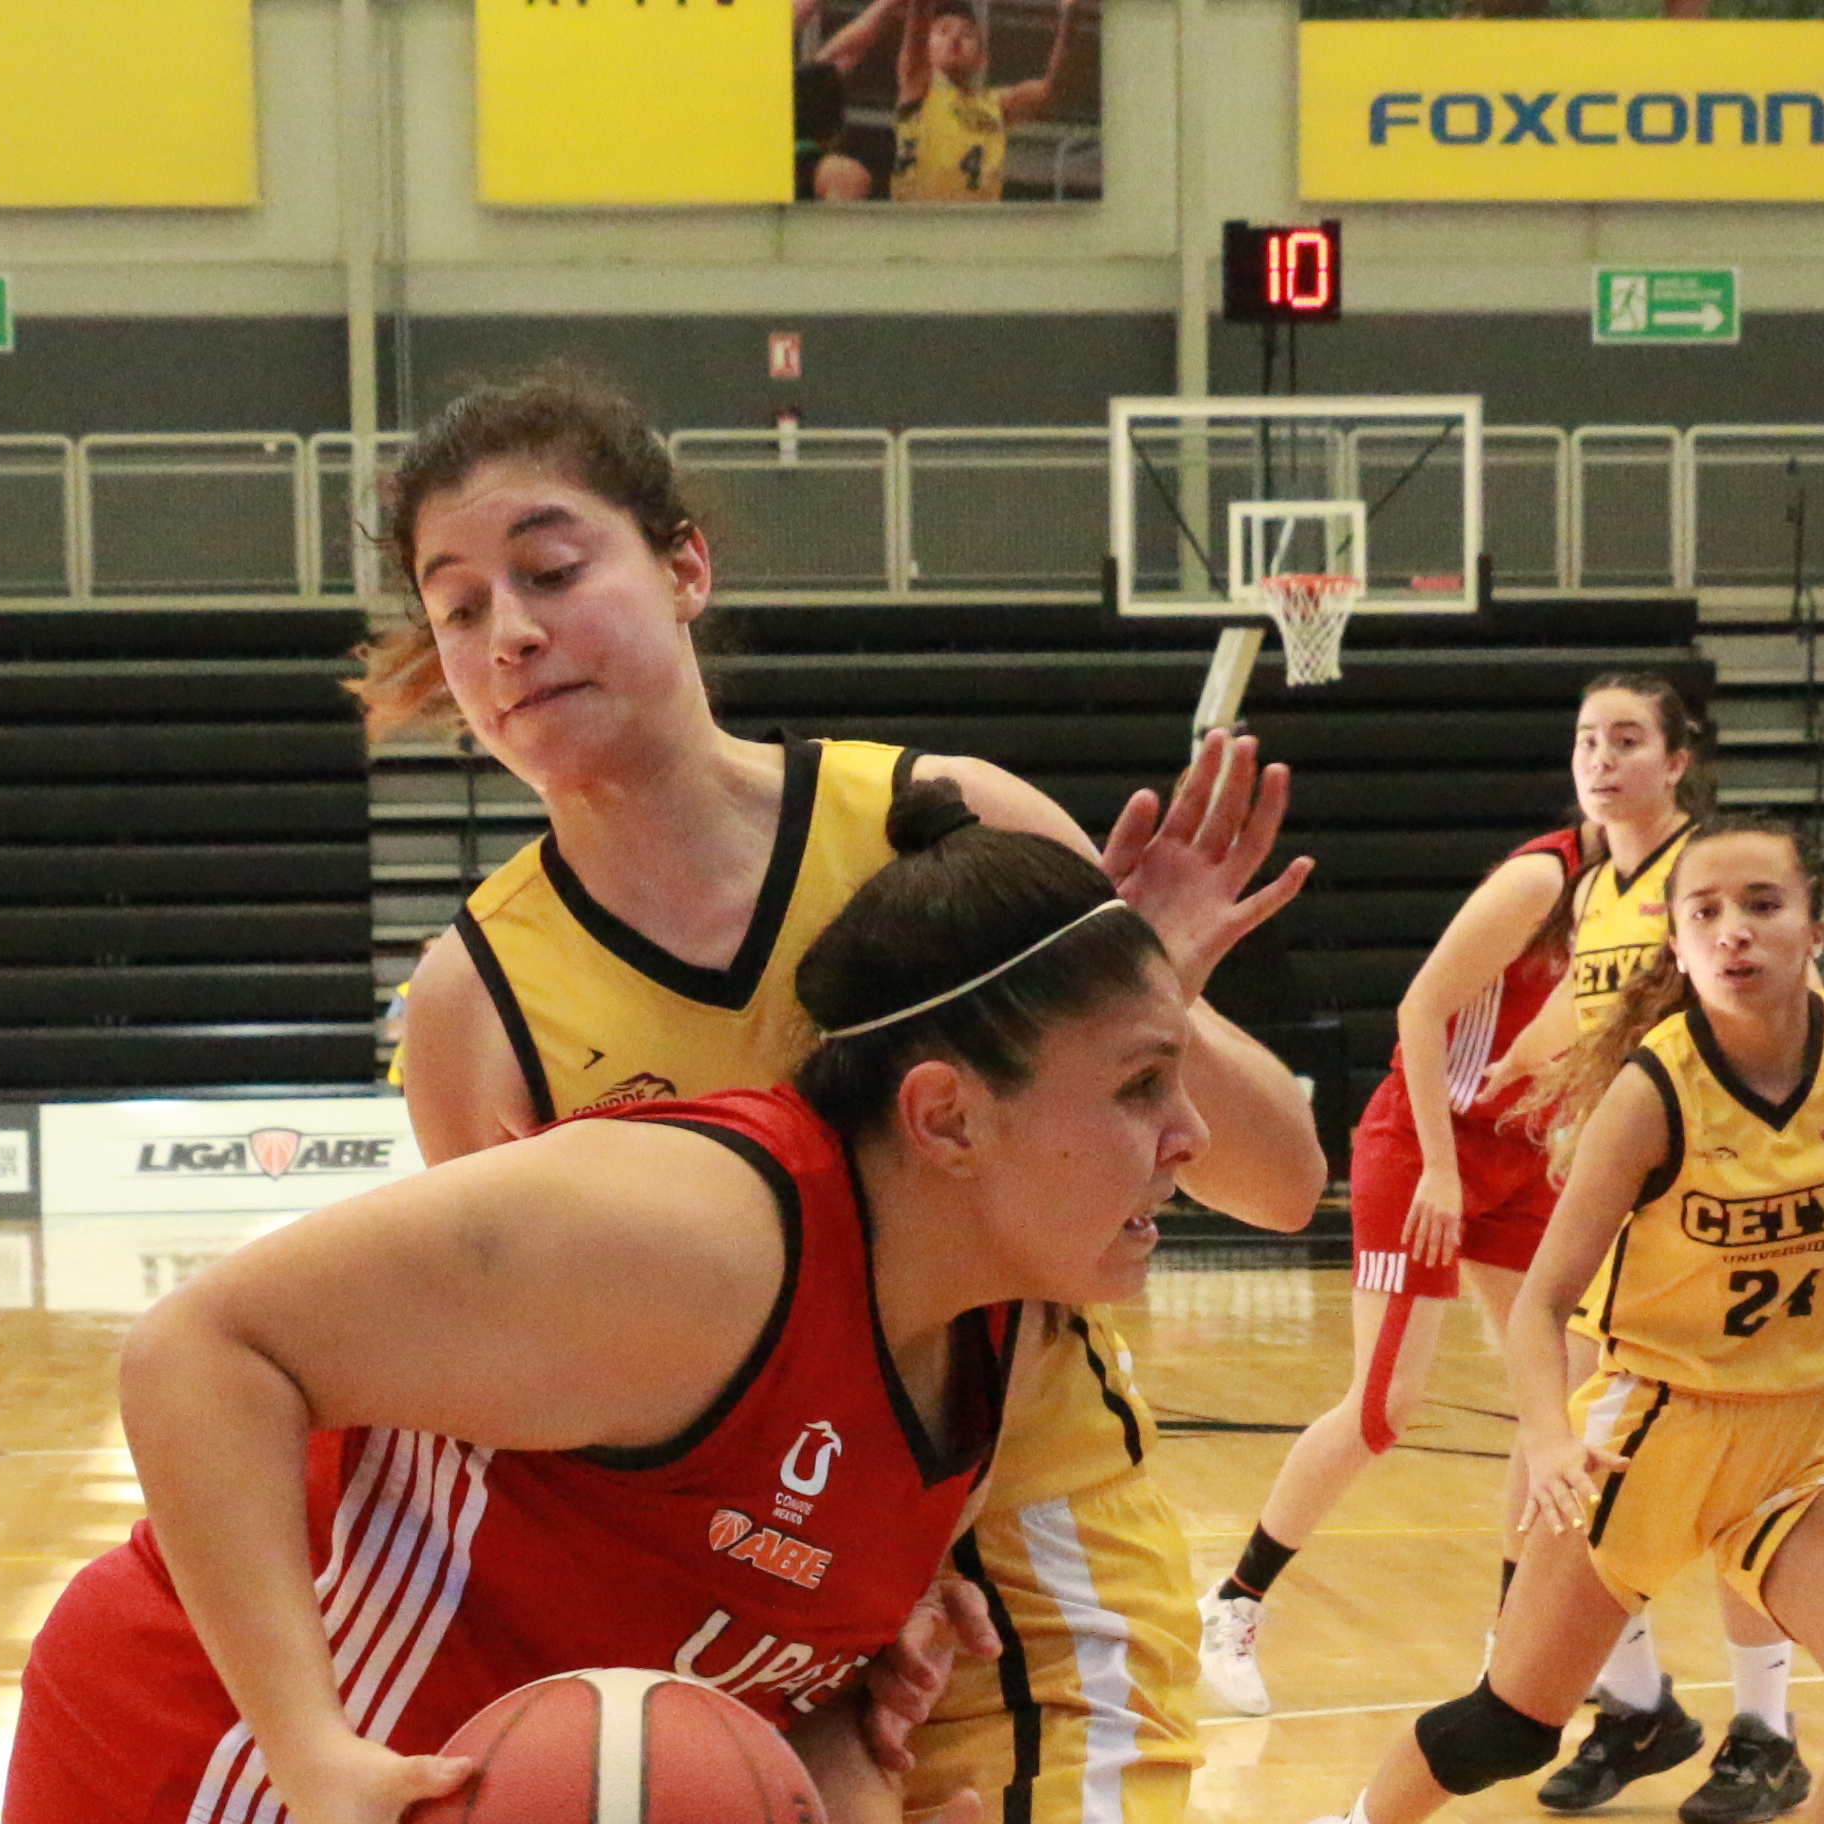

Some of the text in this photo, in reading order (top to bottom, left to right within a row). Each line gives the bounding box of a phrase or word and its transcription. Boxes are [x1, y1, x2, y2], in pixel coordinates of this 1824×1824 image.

[1267, 230, 1329, 310] 10
[1575, 945, 1659, 995] ETY
[137, 1138, 395, 1173] LIGA ABE
[1723, 1267, 1821, 1338] 24
[727, 1527, 833, 1590] ABE
